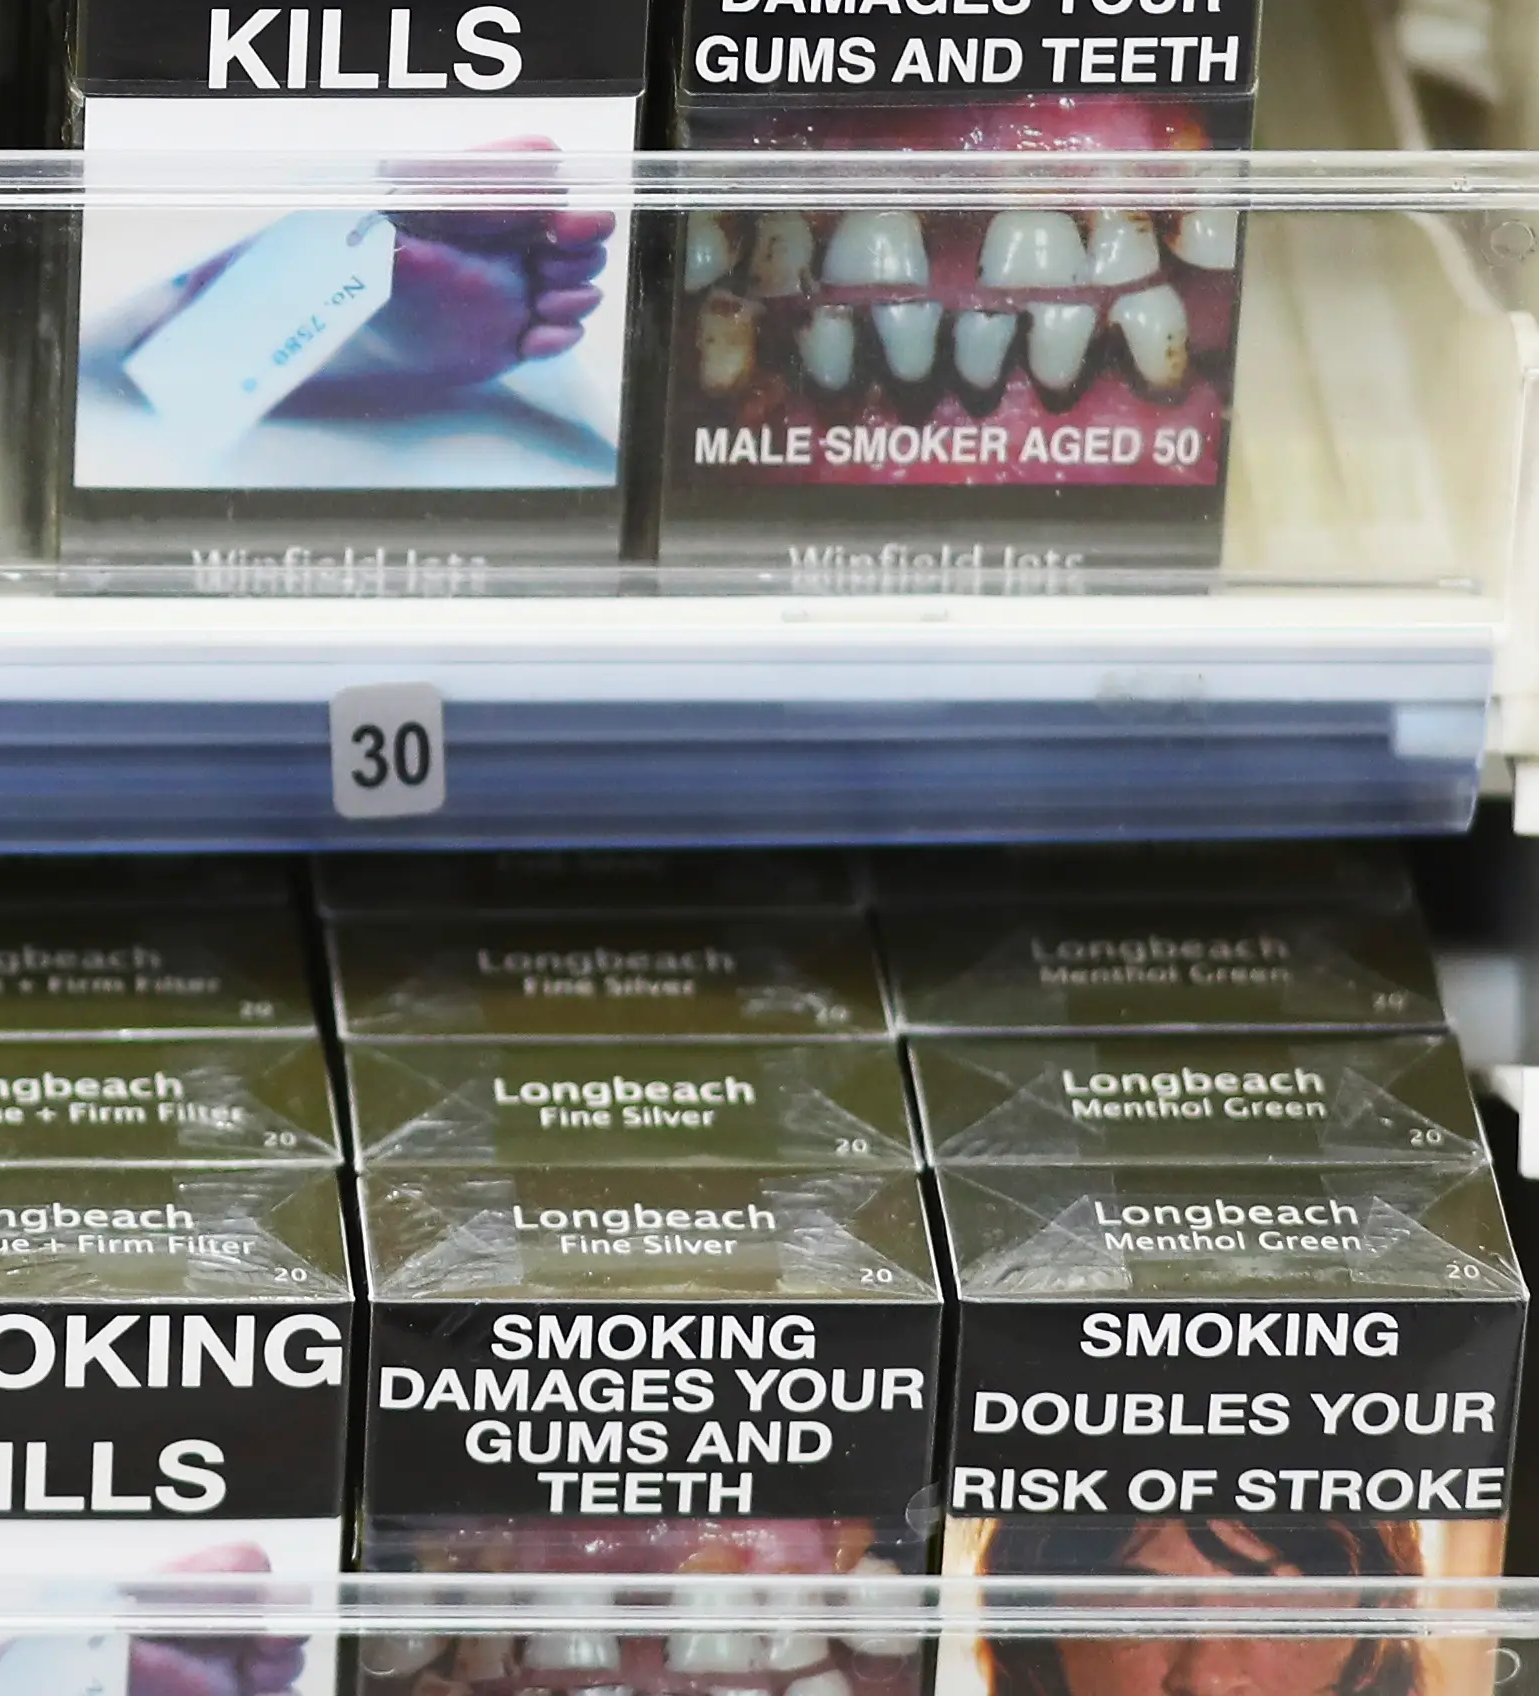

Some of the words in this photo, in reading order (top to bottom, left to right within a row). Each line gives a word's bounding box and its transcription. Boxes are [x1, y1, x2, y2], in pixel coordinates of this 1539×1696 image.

[209, 6, 521, 90] KILLS
[352, 723, 430, 789] 30
[1095, 1199, 1358, 1230] Longbeach
[1105, 1231, 1245, 1252] Menthol
[1259, 1232, 1361, 1251] Green
[1447, 1265, 1479, 1279] 20
[1081, 1313, 1398, 1357] SMOKING
[974, 1392, 1289, 1435] DOUBLES
[1311, 1392, 1495, 1434] YOUR
[953, 1467, 1107, 1510] RISK
[1129, 1470, 1217, 1511] OF
[1236, 1468, 1504, 1511] STROKE
